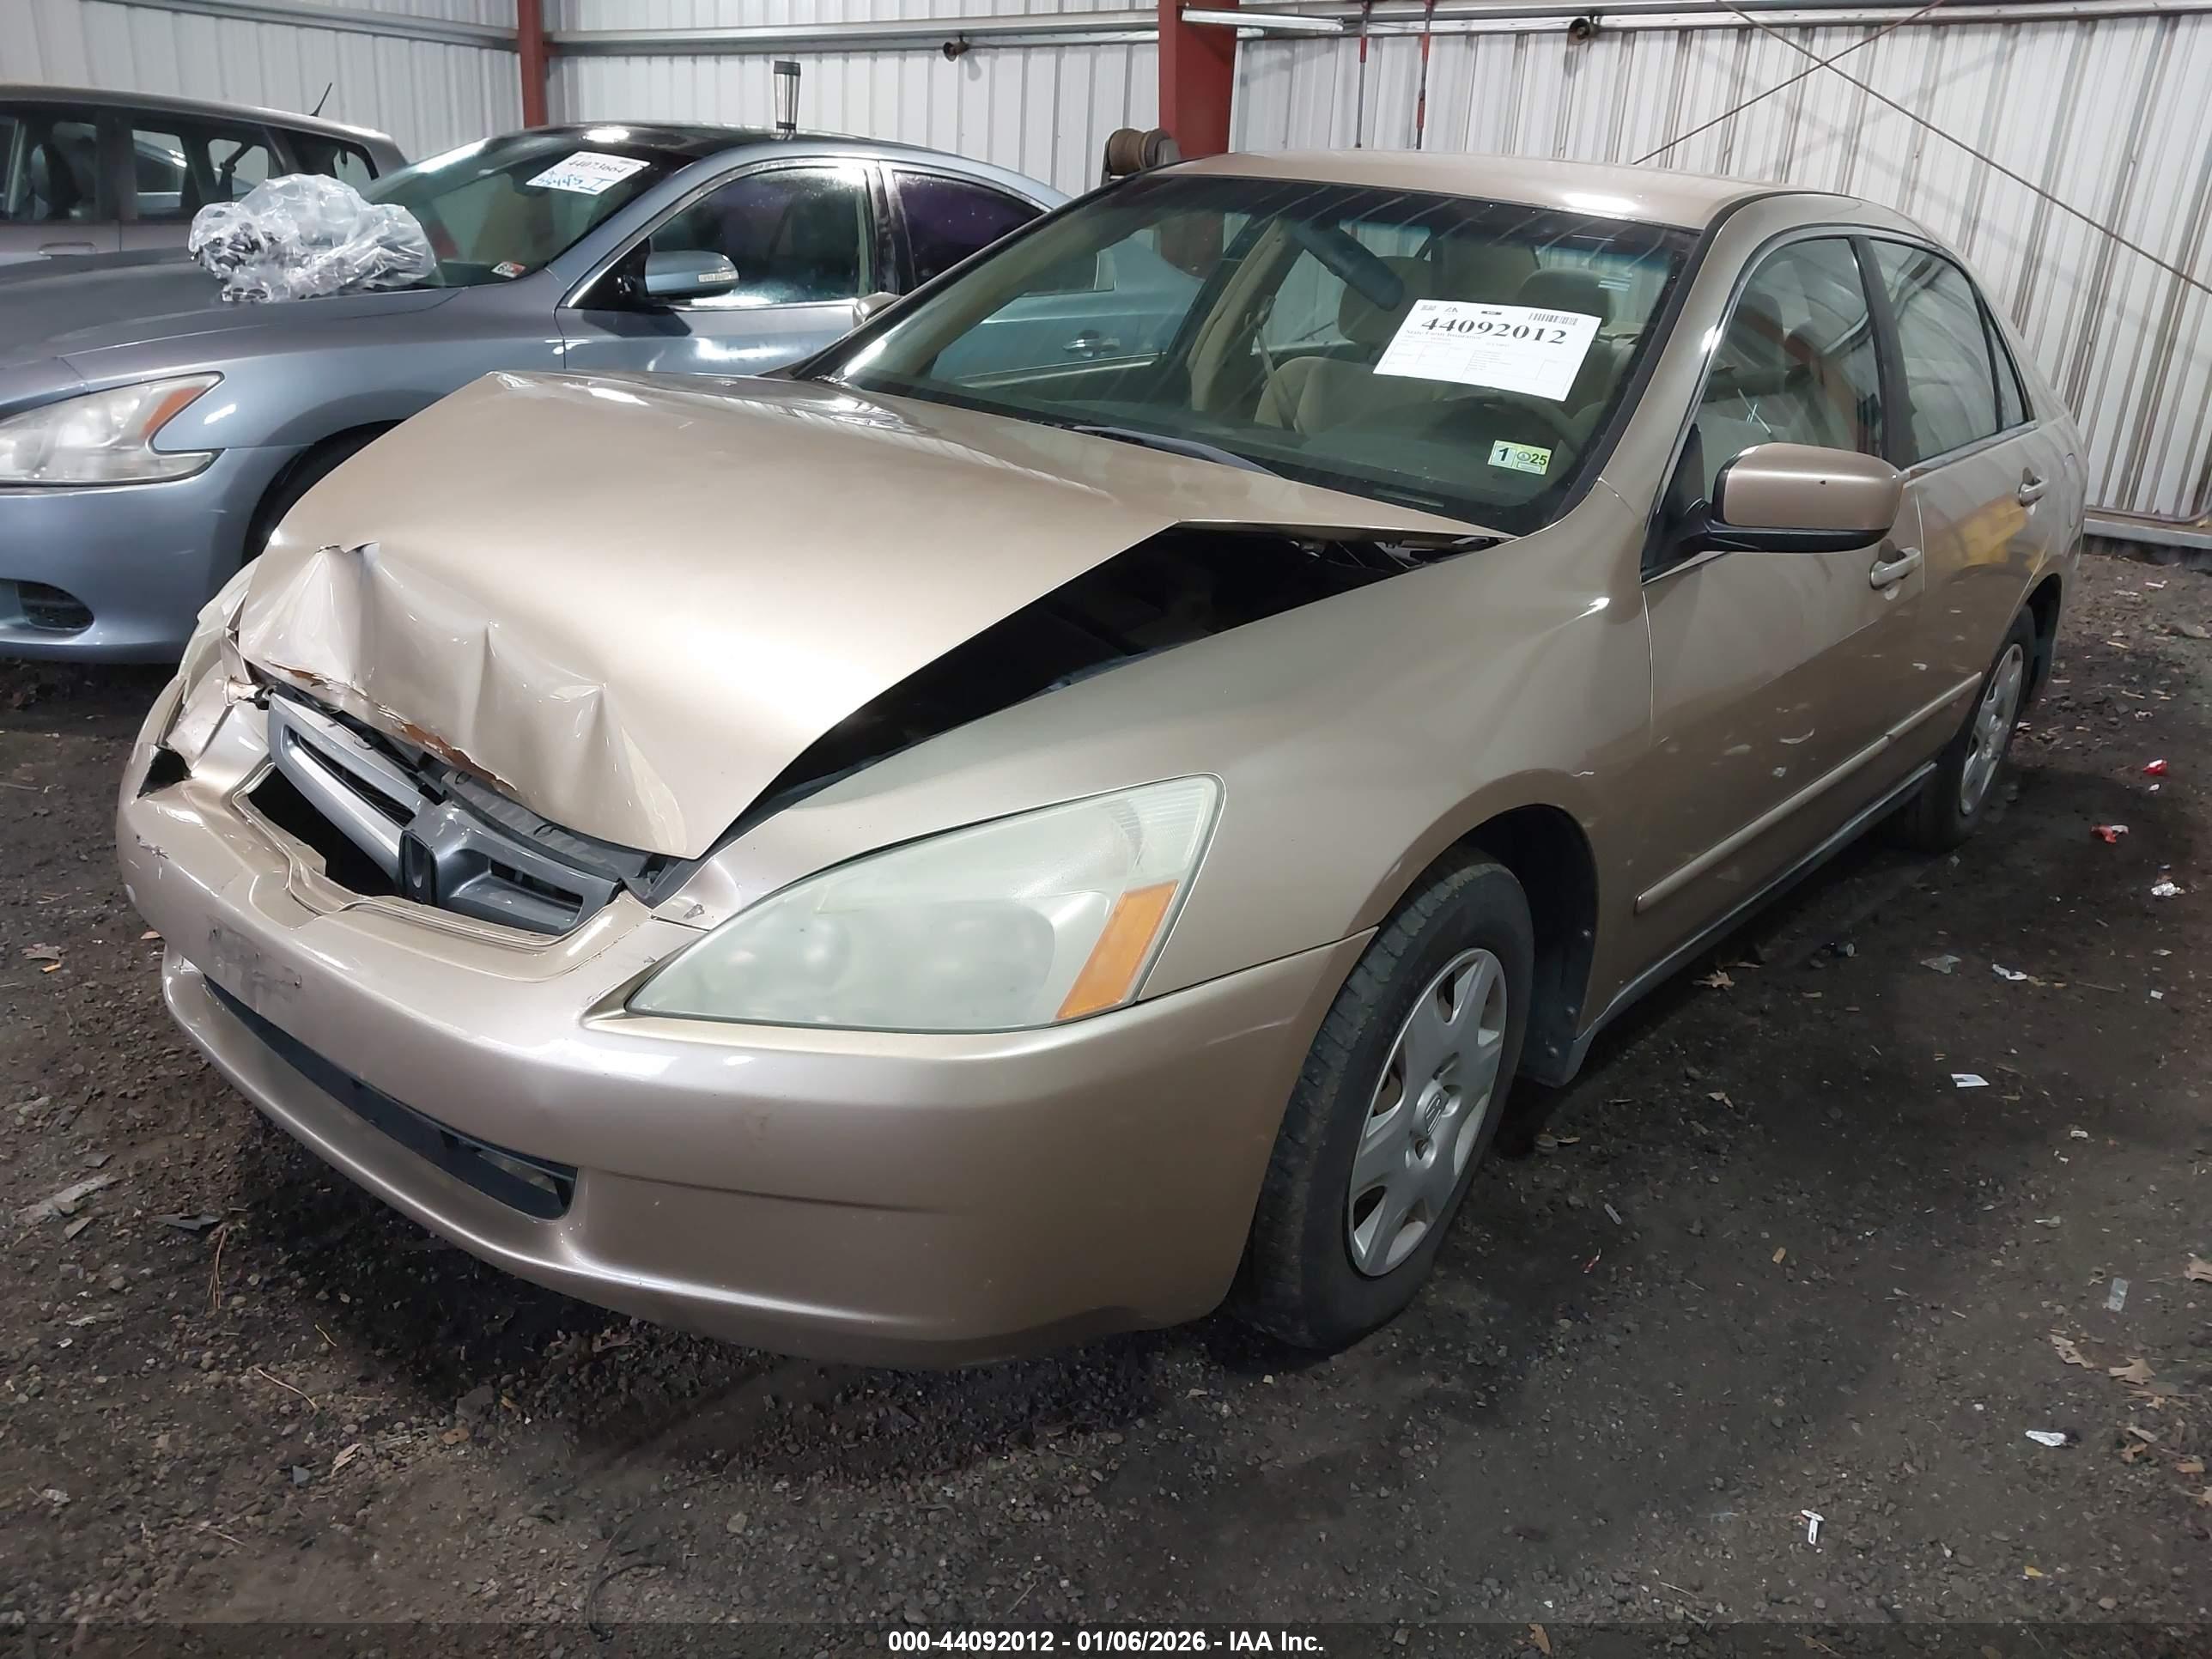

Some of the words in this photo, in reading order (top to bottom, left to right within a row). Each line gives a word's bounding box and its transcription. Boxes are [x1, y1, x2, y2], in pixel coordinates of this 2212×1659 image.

[1421, 317, 1567, 344] 44092012
[1498, 447, 1510, 462] 1
[1530, 453, 1548, 466] 25
